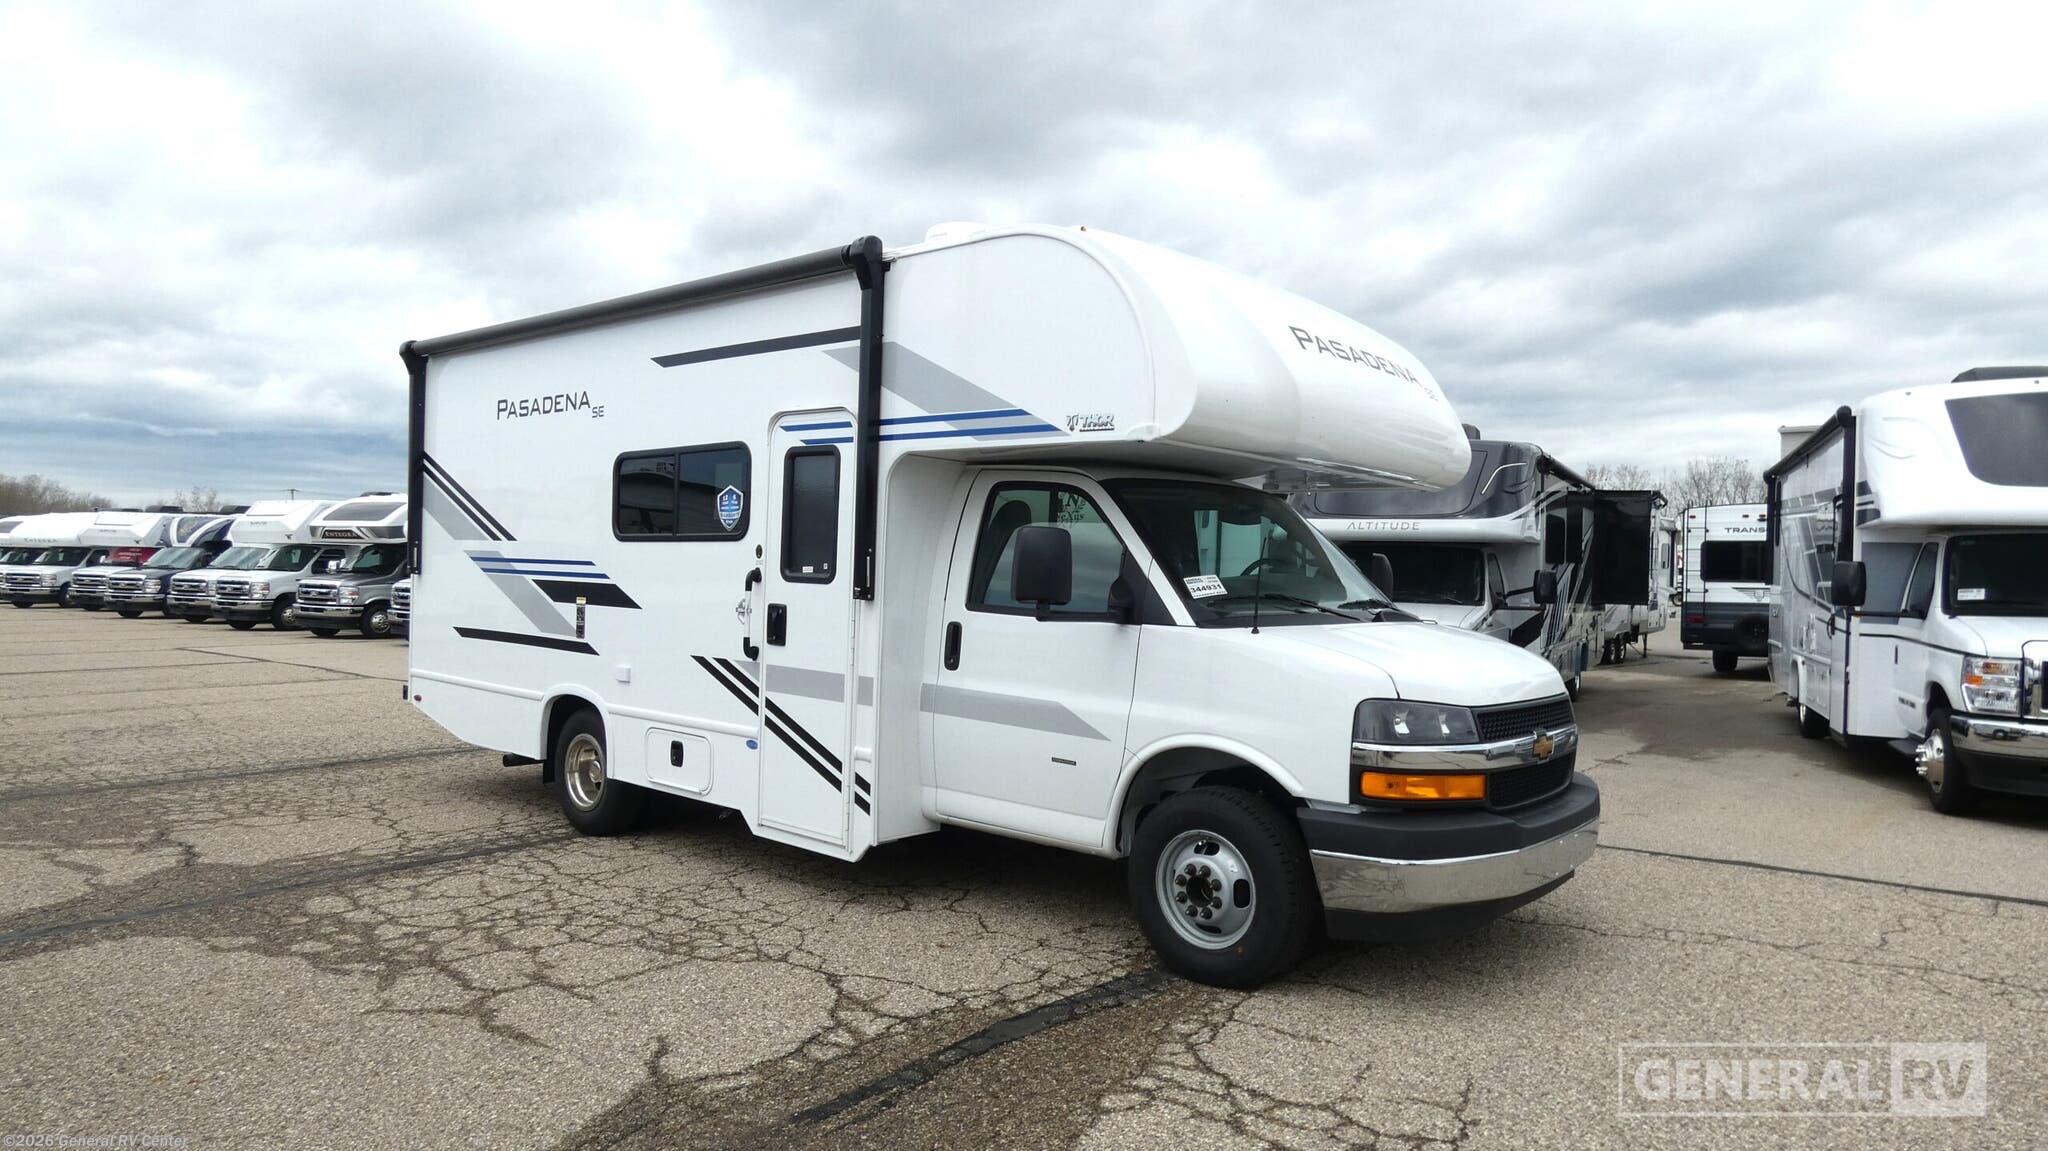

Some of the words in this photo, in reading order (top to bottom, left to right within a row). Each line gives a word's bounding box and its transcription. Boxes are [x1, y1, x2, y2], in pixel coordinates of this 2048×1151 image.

[1288, 325, 1423, 388] PASADENA
[497, 391, 591, 420] PASADENA
[592, 405, 604, 418] SE
[1080, 414, 1114, 428] THOR
[1347, 521, 1420, 530] ALTITUDE
[1190, 584, 1222, 593] 344931
